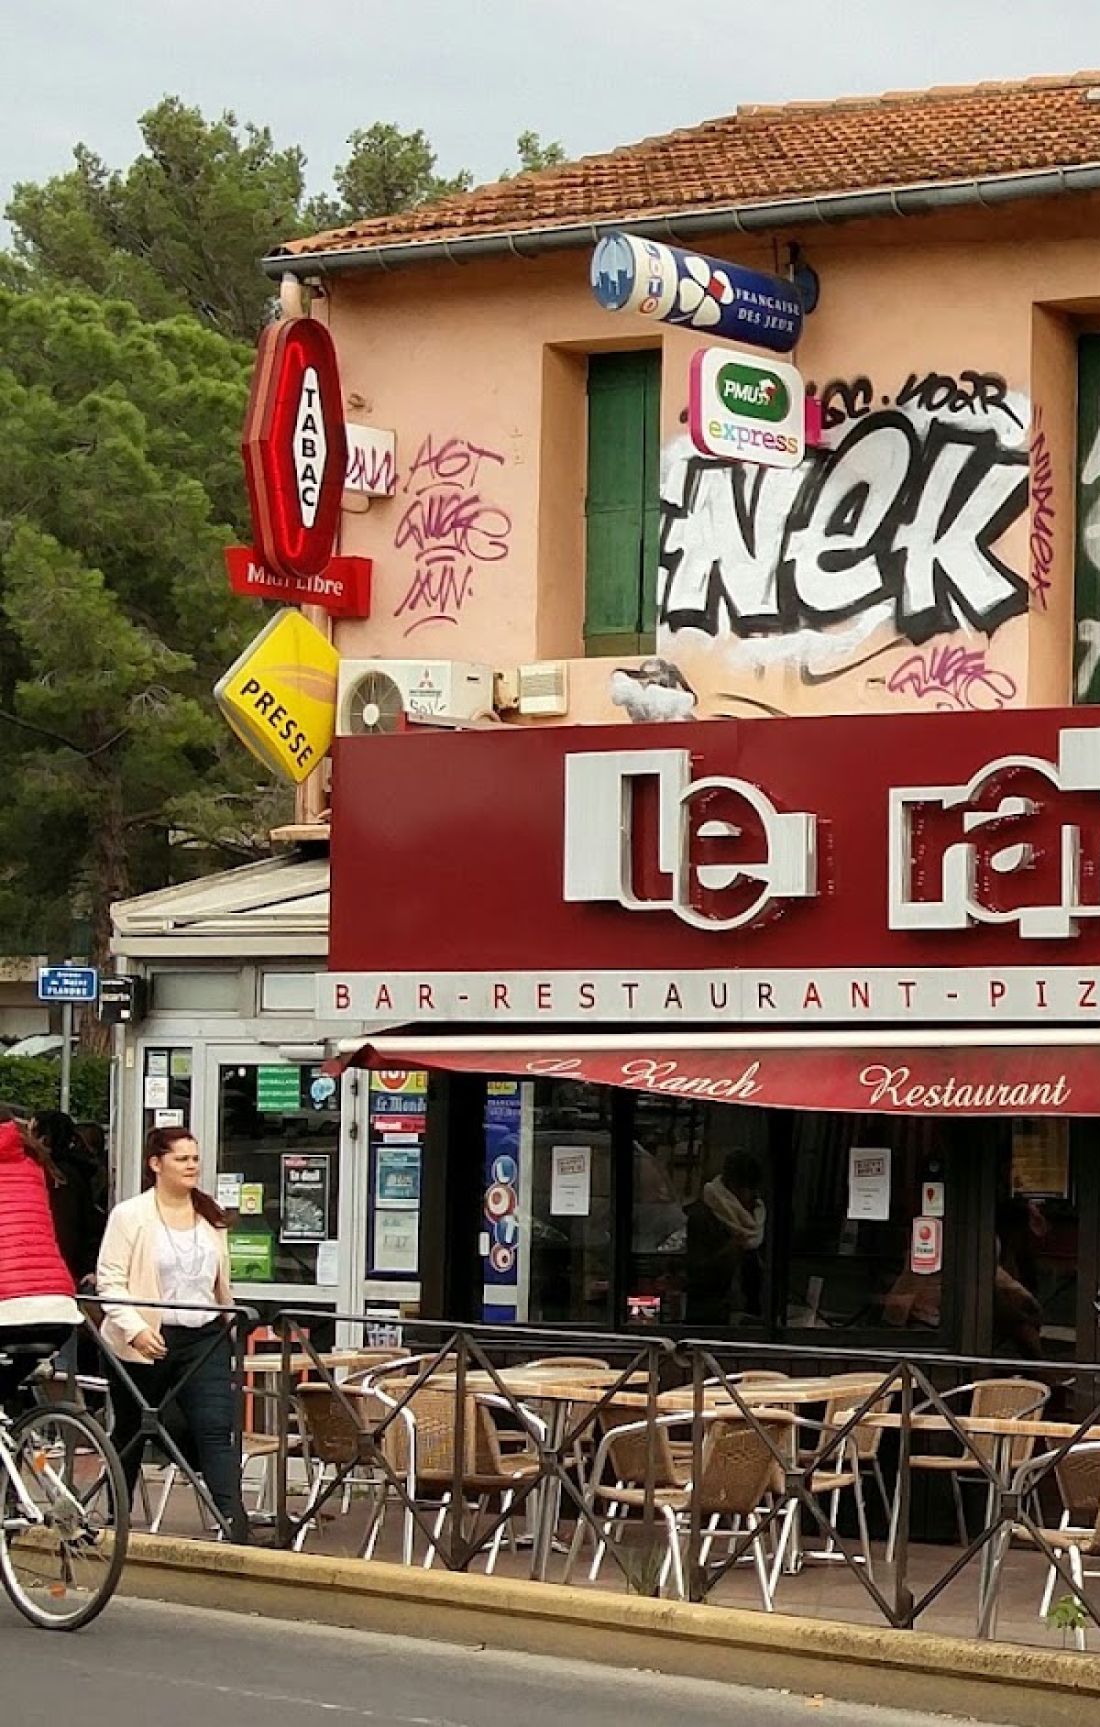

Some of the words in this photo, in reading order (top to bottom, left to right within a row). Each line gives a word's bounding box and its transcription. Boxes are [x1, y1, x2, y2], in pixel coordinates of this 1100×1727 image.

[738, 307, 761, 324] DES
[763, 315, 794, 332] JEUX
[722, 378, 760, 405] PMU
[300, 387, 318, 508] TABAC
[708, 420, 799, 454] express
[239, 677, 314, 768] PRESSE
[564, 749, 818, 931] le
[620, 1058, 763, 1099] Ranch
[859, 1063, 1072, 1109] Restaurant
